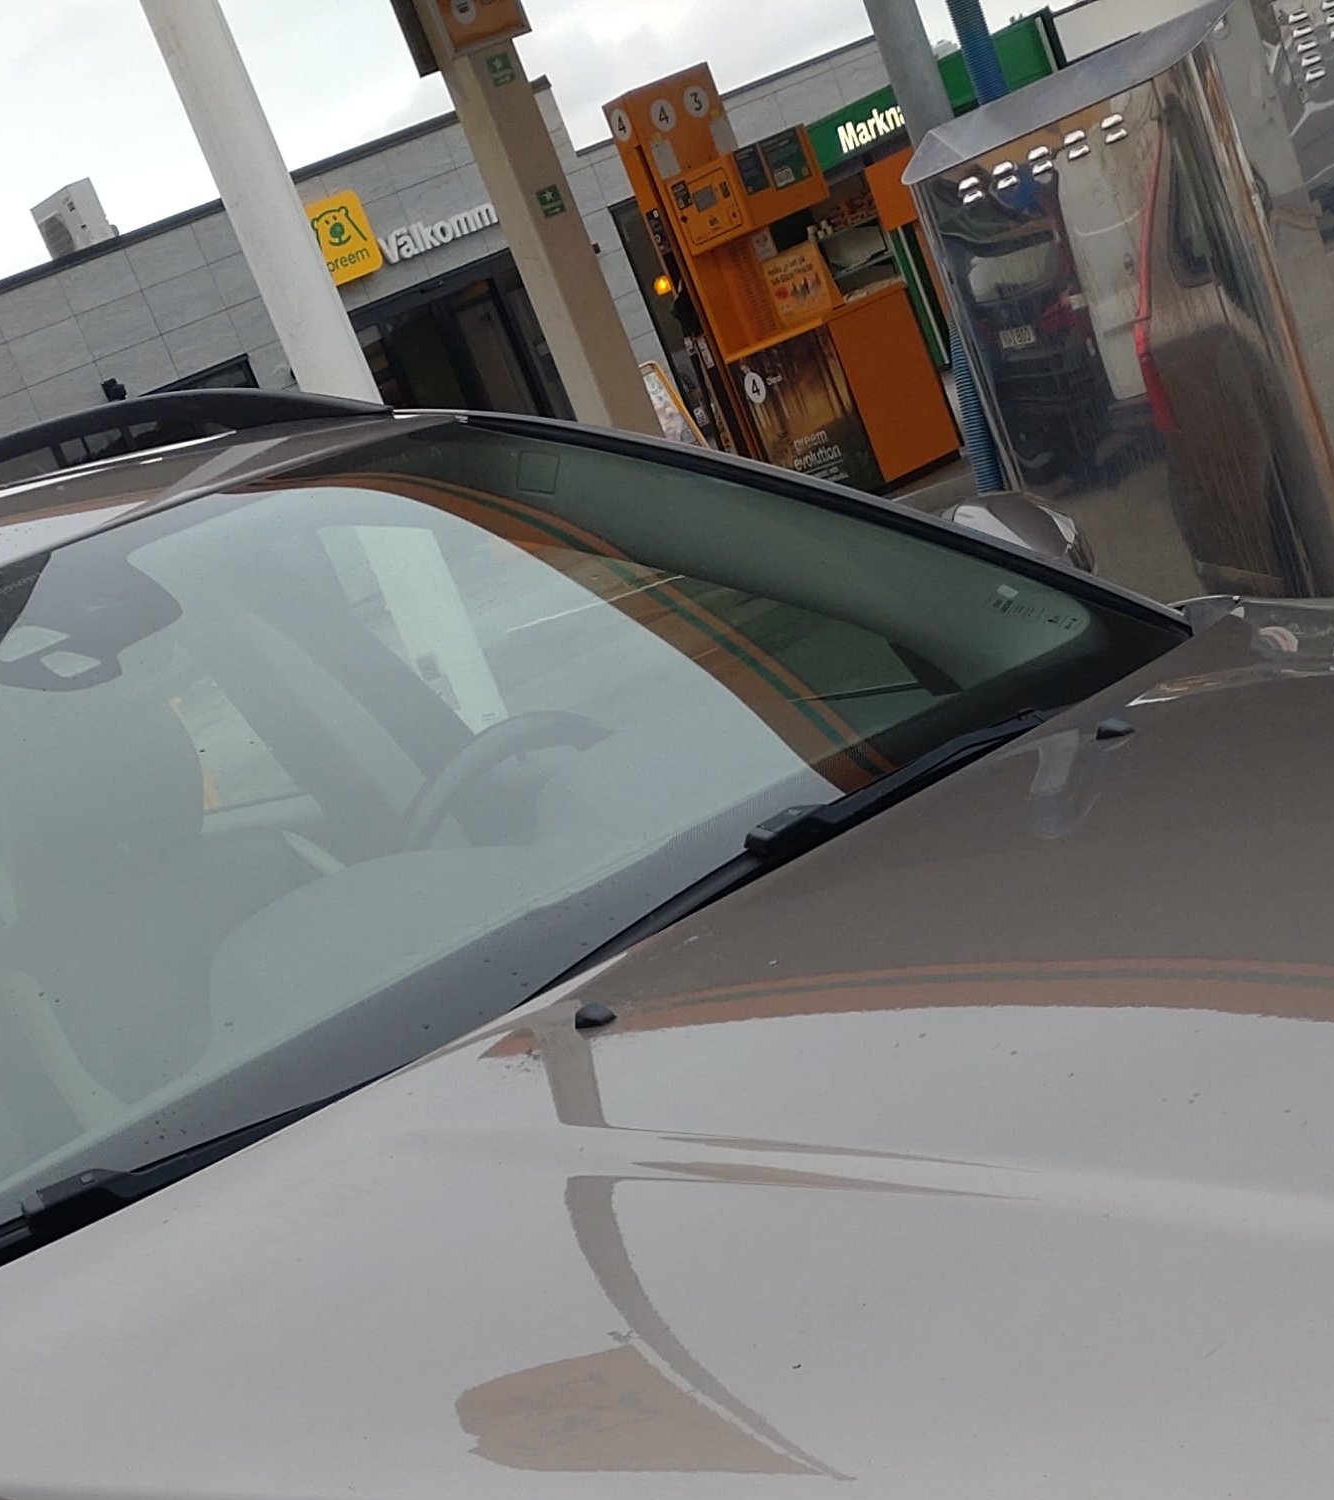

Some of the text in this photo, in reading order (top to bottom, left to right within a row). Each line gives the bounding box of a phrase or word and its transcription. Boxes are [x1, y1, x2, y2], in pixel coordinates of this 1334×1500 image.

[690, 92, 703, 111] 3
[658, 105, 670, 124] 4
[617, 116, 627, 134] 4
[327, 248, 371, 277] preem
[751, 379, 761, 396] 4
[793, 429, 829, 454] preem
[793, 443, 842, 472] evolution
